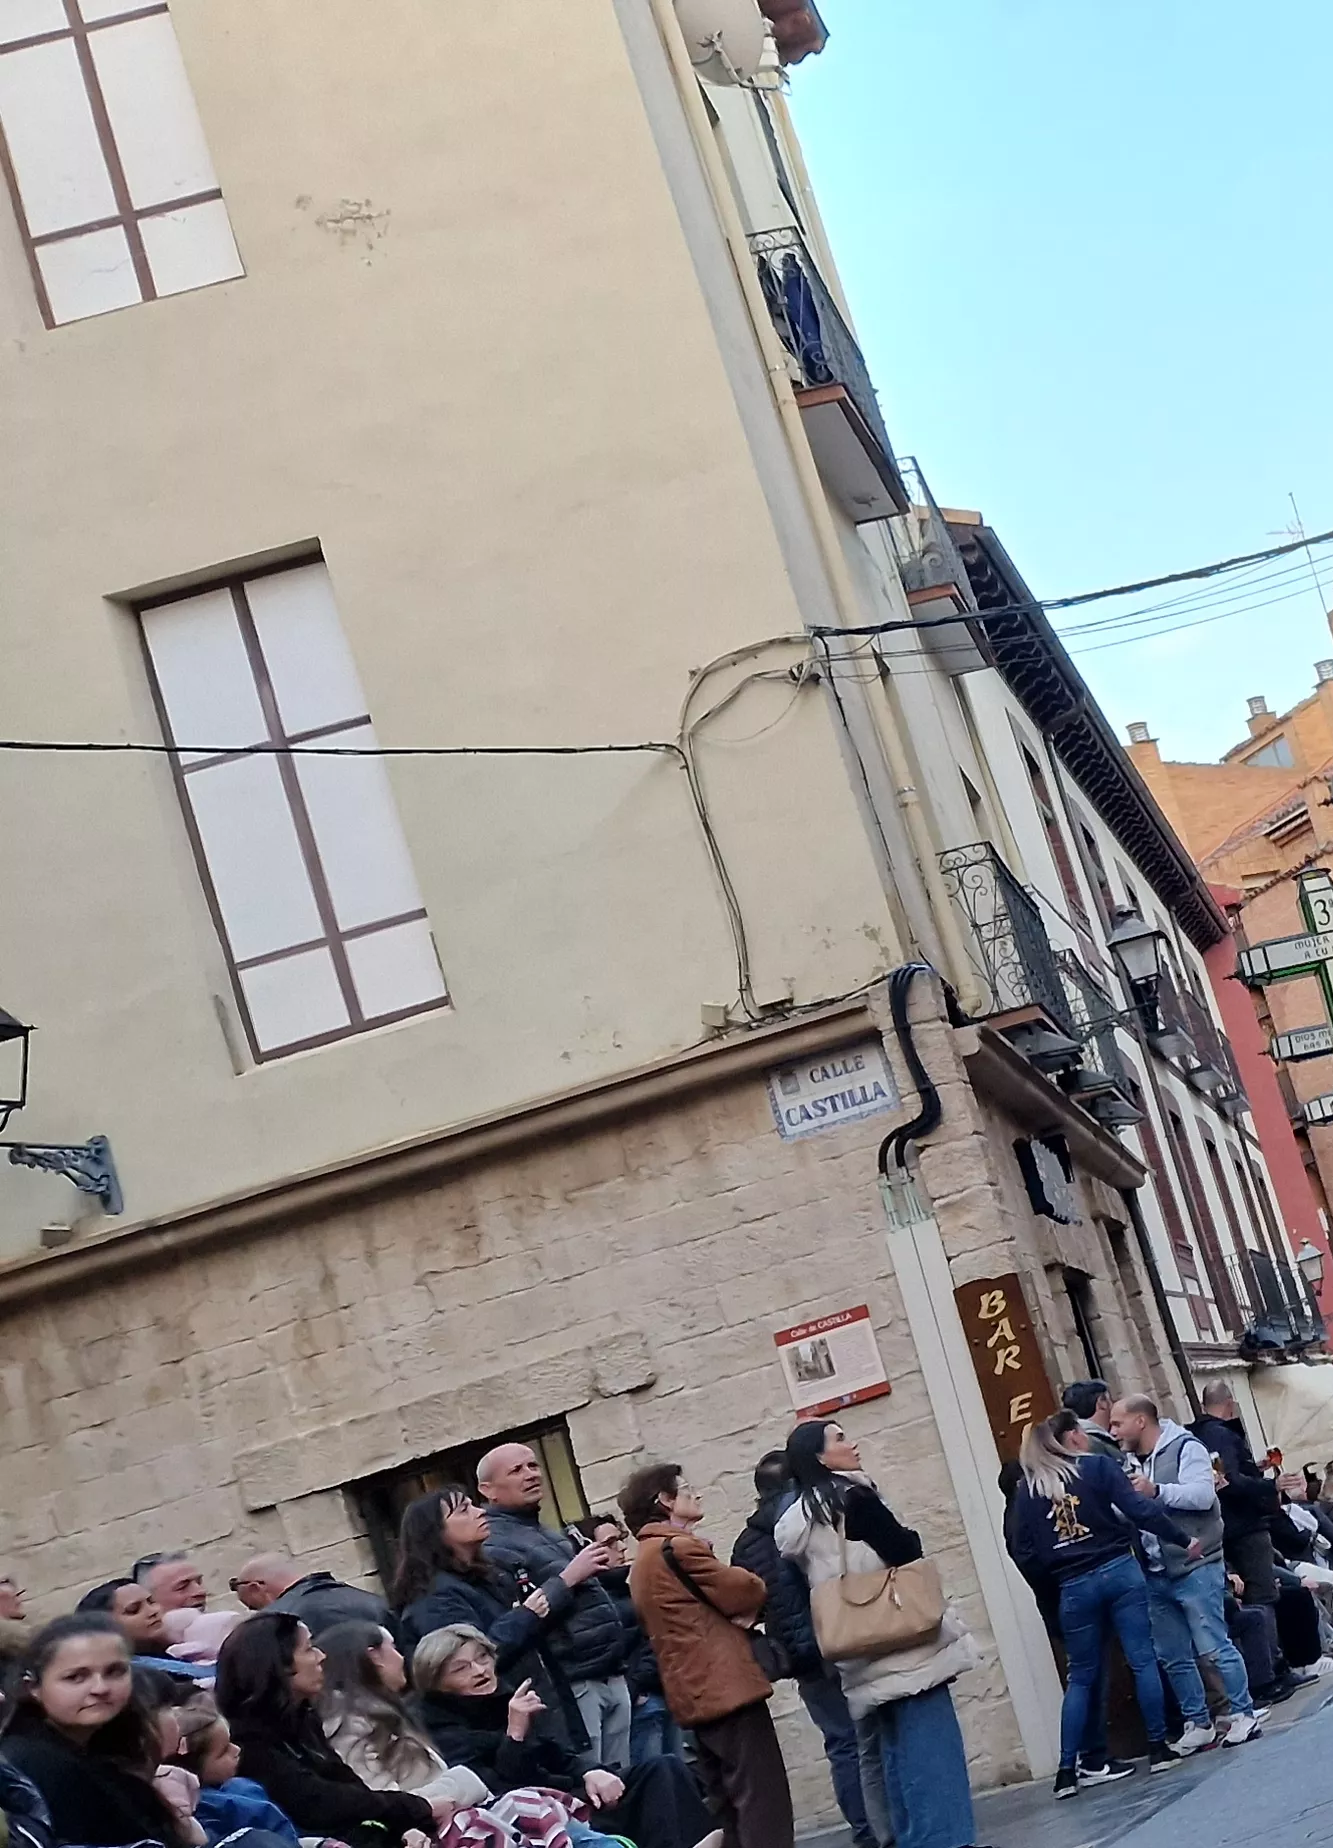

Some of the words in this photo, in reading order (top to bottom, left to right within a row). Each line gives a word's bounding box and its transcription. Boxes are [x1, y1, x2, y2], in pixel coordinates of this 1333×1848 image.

[809, 1055, 865, 1083] CALLE
[784, 1081, 888, 1127] CASTILLA
[817, 1313, 852, 1328] CASTILLA
[977, 1289, 1023, 1376] BAR
